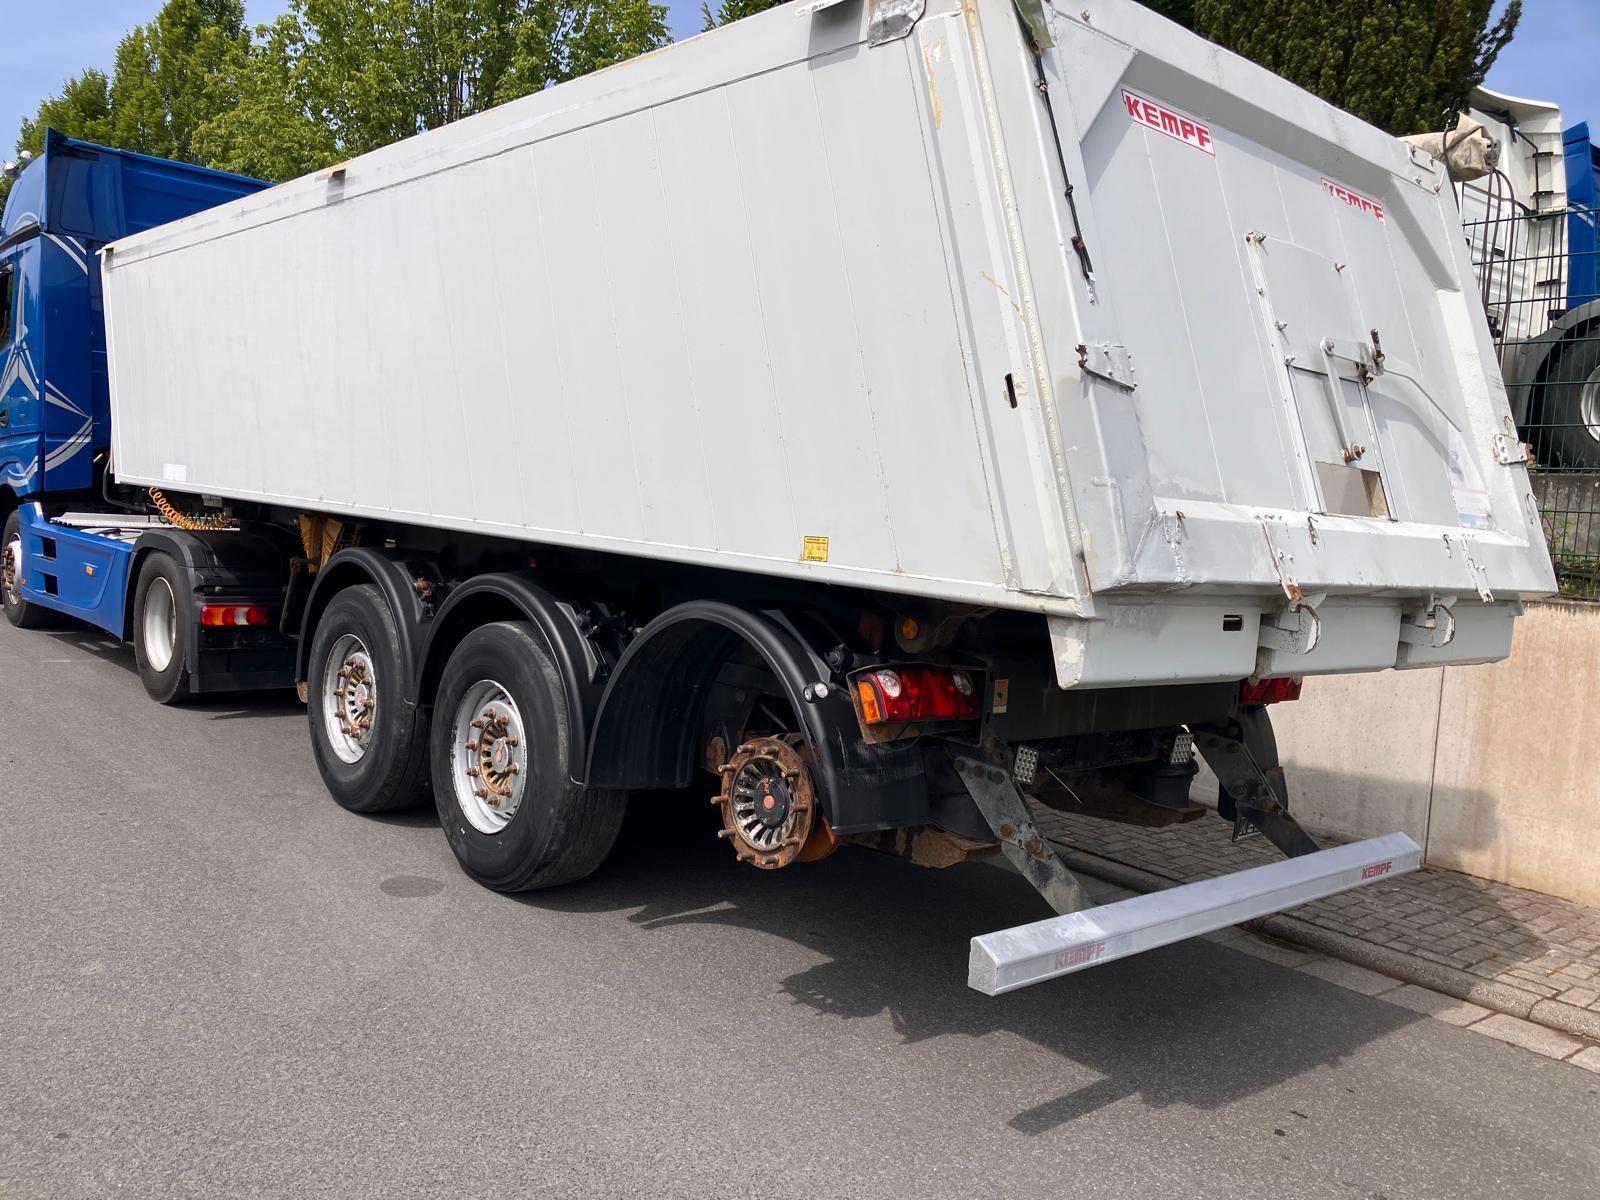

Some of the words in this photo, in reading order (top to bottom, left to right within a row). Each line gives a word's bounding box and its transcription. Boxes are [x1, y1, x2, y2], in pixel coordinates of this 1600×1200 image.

[1125, 95, 1211, 147] KEMPF
[1361, 860, 1393, 880] KEMPF
[1055, 942, 1104, 969] KEMPF
